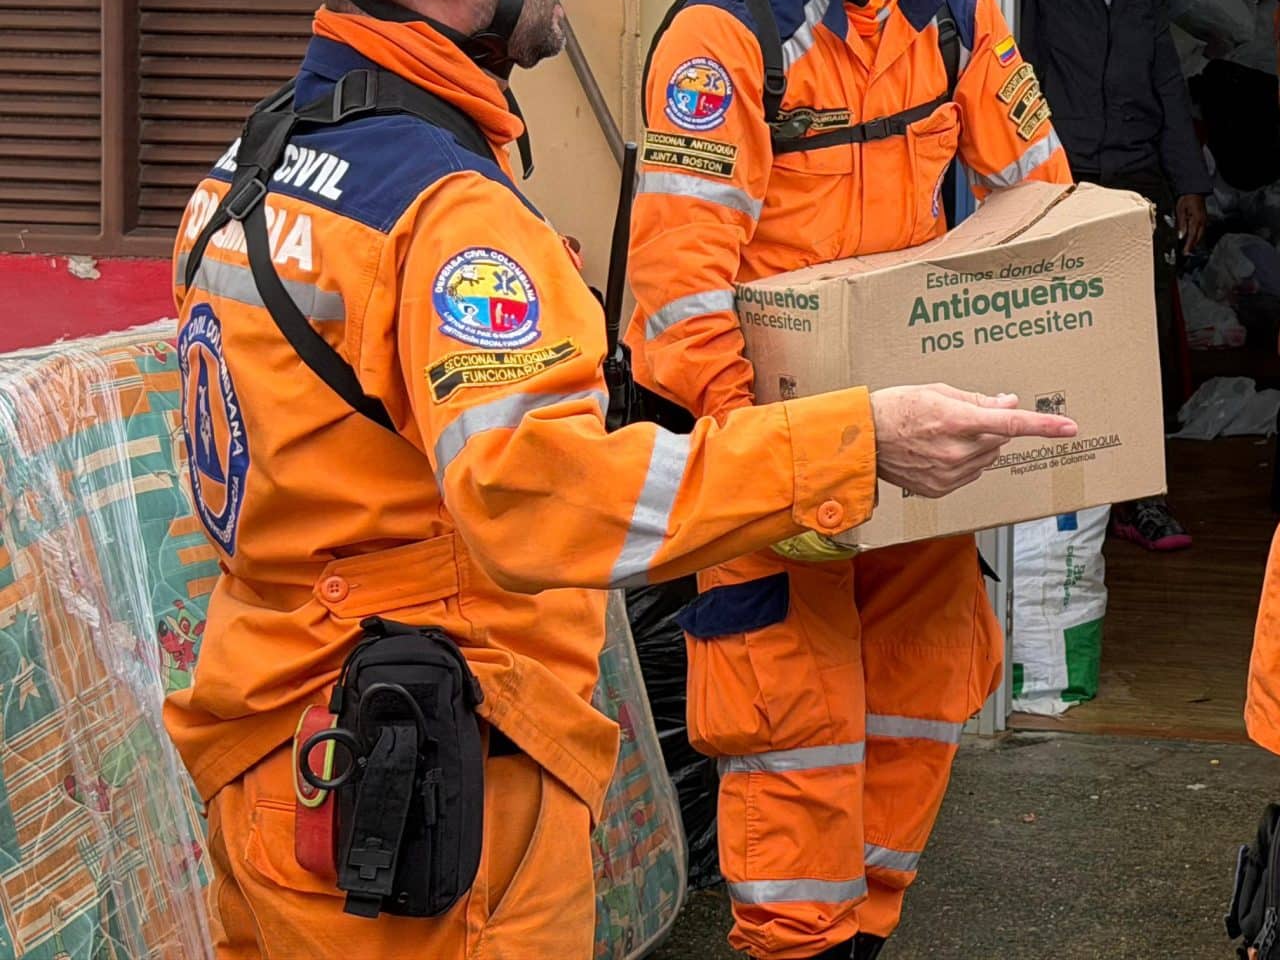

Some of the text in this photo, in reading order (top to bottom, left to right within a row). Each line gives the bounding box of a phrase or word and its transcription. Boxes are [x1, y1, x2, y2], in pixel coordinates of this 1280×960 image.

[273, 143, 350, 201] CIVIL
[650, 151, 723, 172] JUNTA BOSTON
[464, 250, 490, 259] CIVIL
[926, 255, 1085, 289] Estamos donde los
[908, 276, 1105, 326] Antioqueños
[745, 311, 811, 332] necesiten
[921, 310, 1093, 354] nos necesiten
[444, 348, 557, 373] SECCIONAL ANTIOQUIA
[462, 363, 545, 382] FUNCIONARIO
[992, 434, 1121, 467] OBERNACIÓN DE ANTIOQUIA
[1010, 453, 1096, 476] República de Colombia
